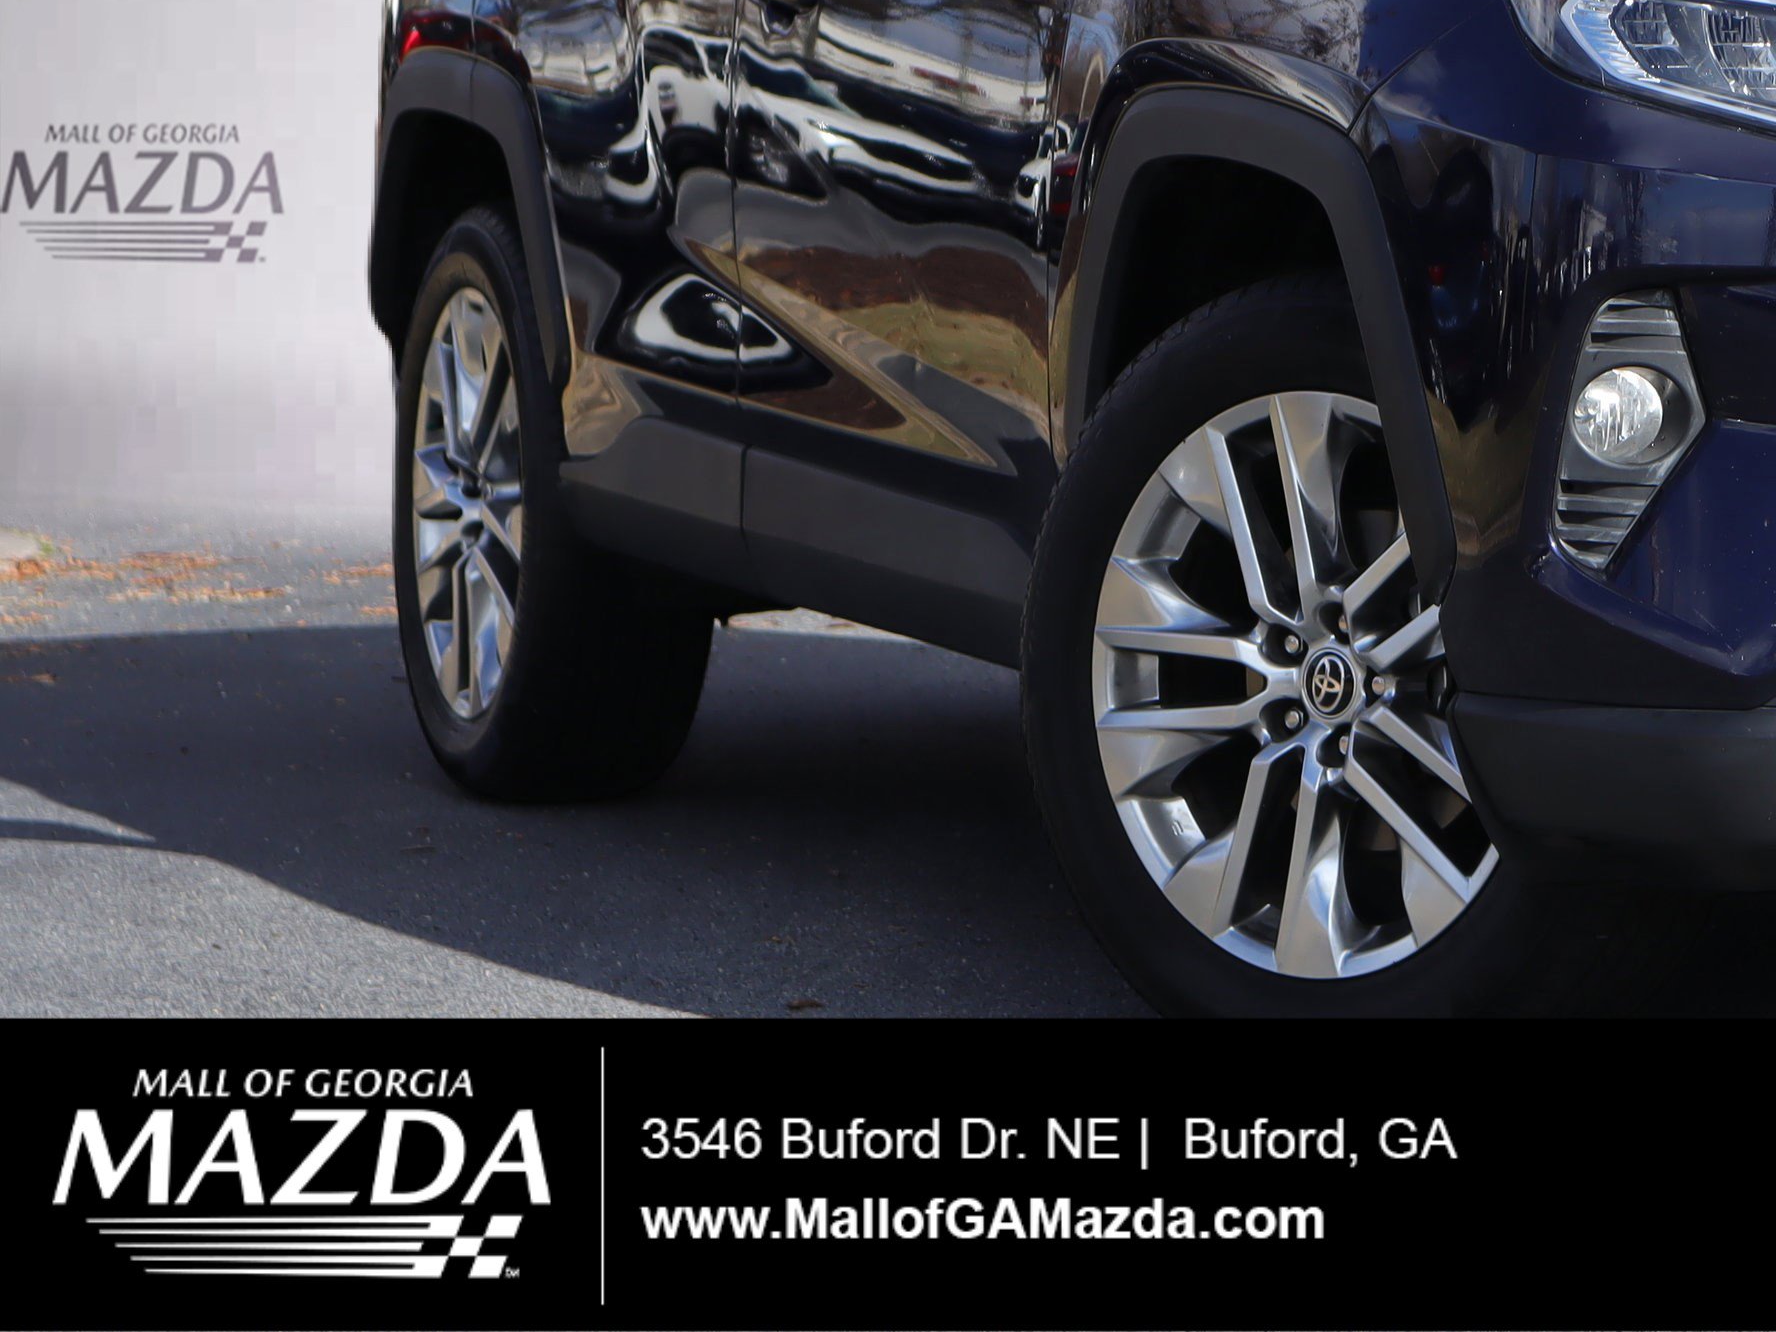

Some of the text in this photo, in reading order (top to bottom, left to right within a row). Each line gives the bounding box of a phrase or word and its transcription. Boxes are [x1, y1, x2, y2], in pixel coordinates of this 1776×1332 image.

[45, 123, 240, 143] MALL OF GEORGIA
[0, 150, 284, 214] MAZDA
